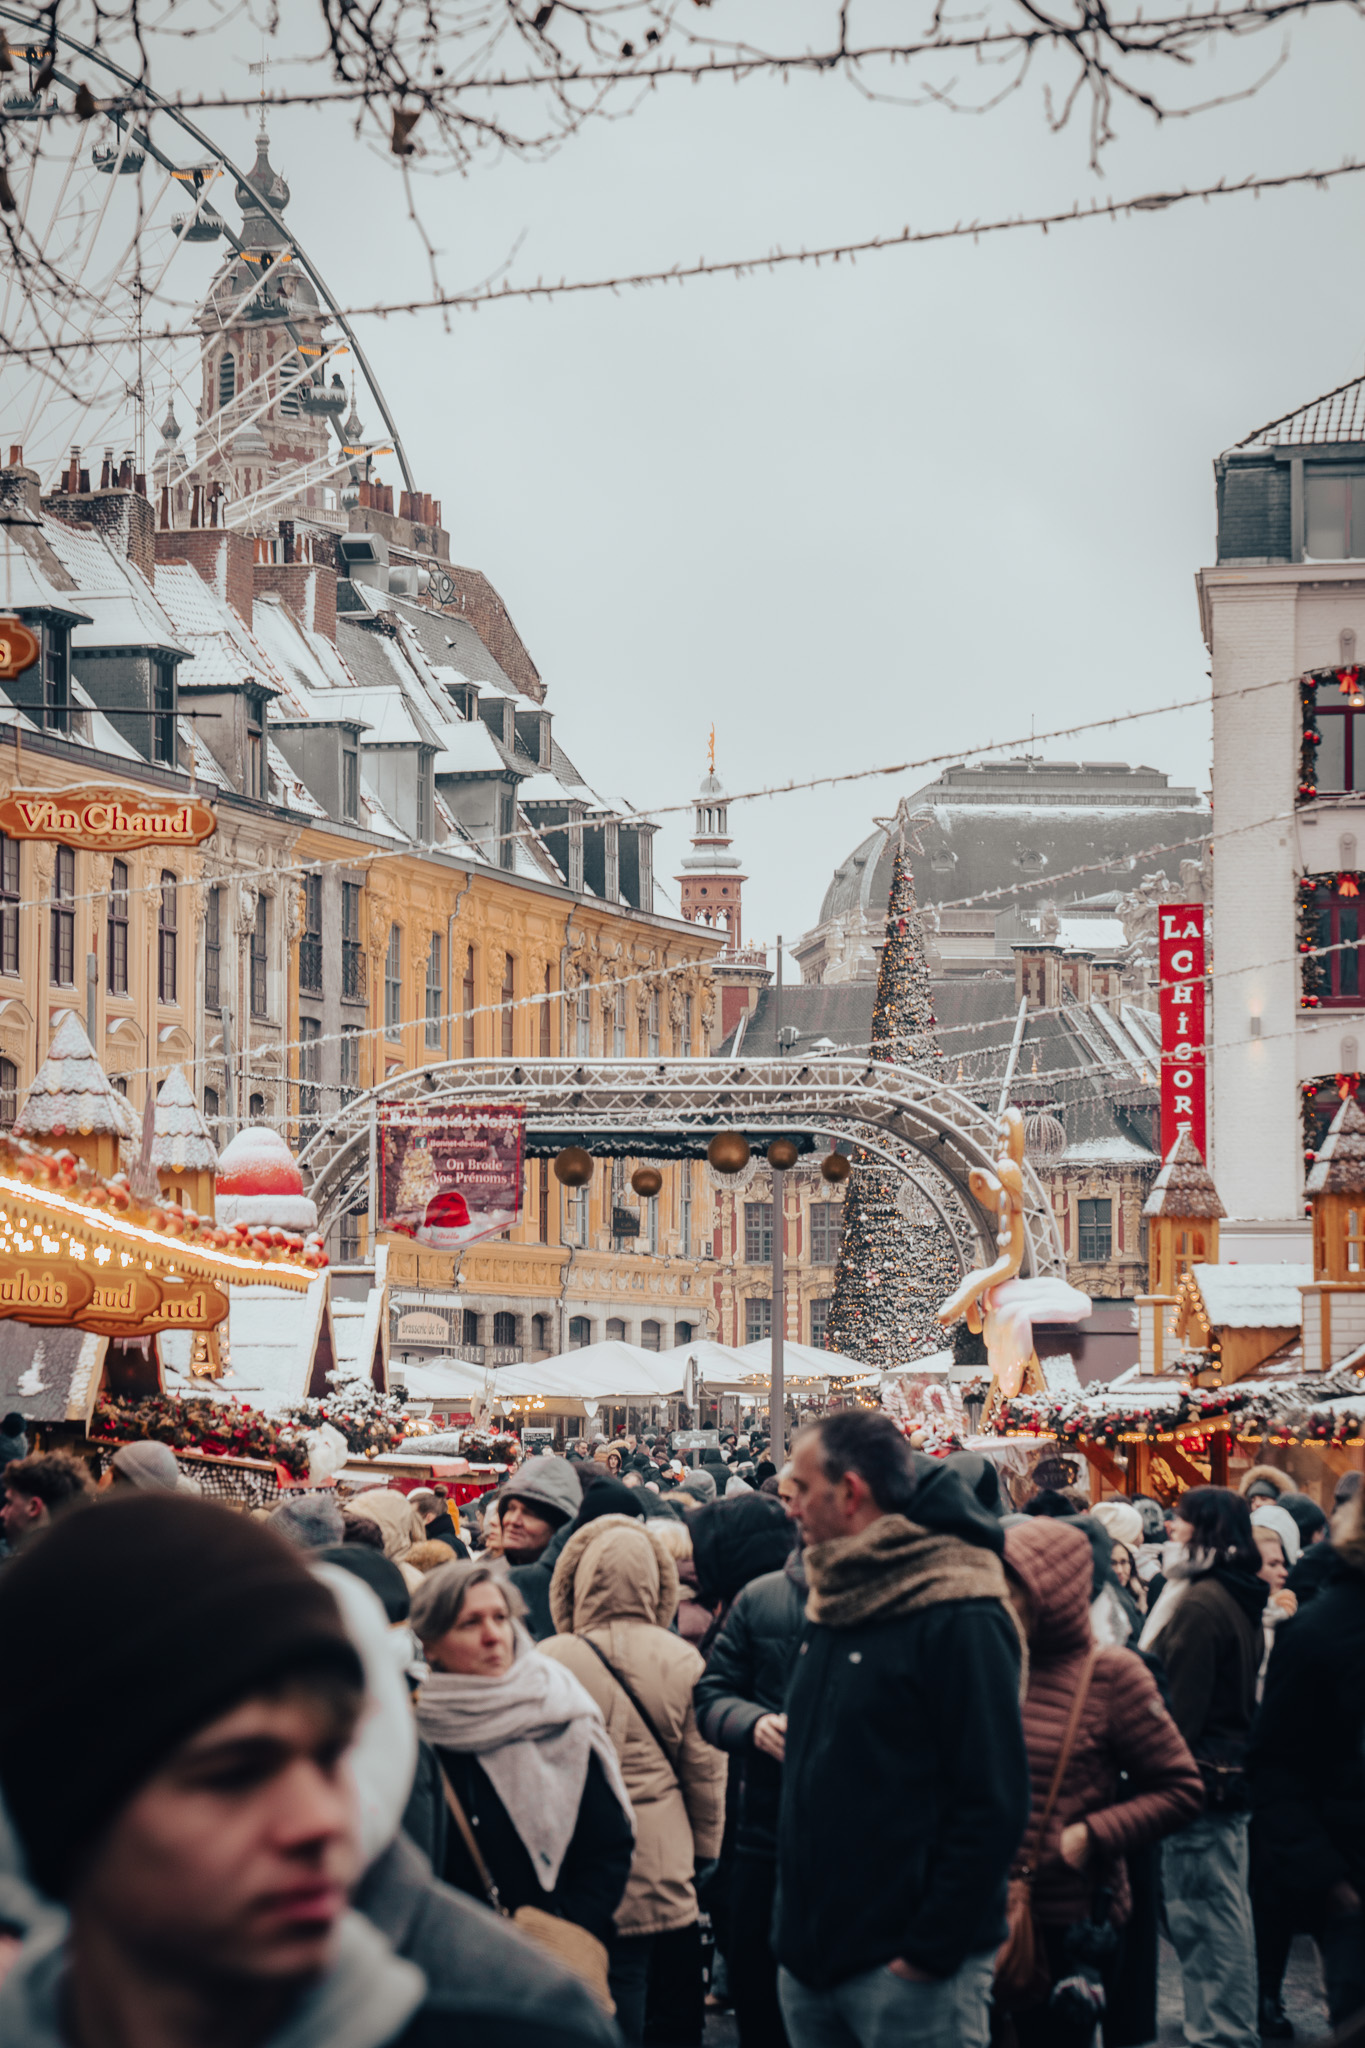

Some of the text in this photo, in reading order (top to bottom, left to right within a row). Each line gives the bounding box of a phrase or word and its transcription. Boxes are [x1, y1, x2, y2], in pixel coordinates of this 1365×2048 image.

[16, 800, 193, 837] Vin Chaud
[446, 1158, 502, 1171] On Brode
[433, 1172, 453, 1183] Vos
[455, 1171, 507, 1184] Prénoms
[402, 1321, 427, 1335] Brasserie
[428, 1324, 435, 1336] de
